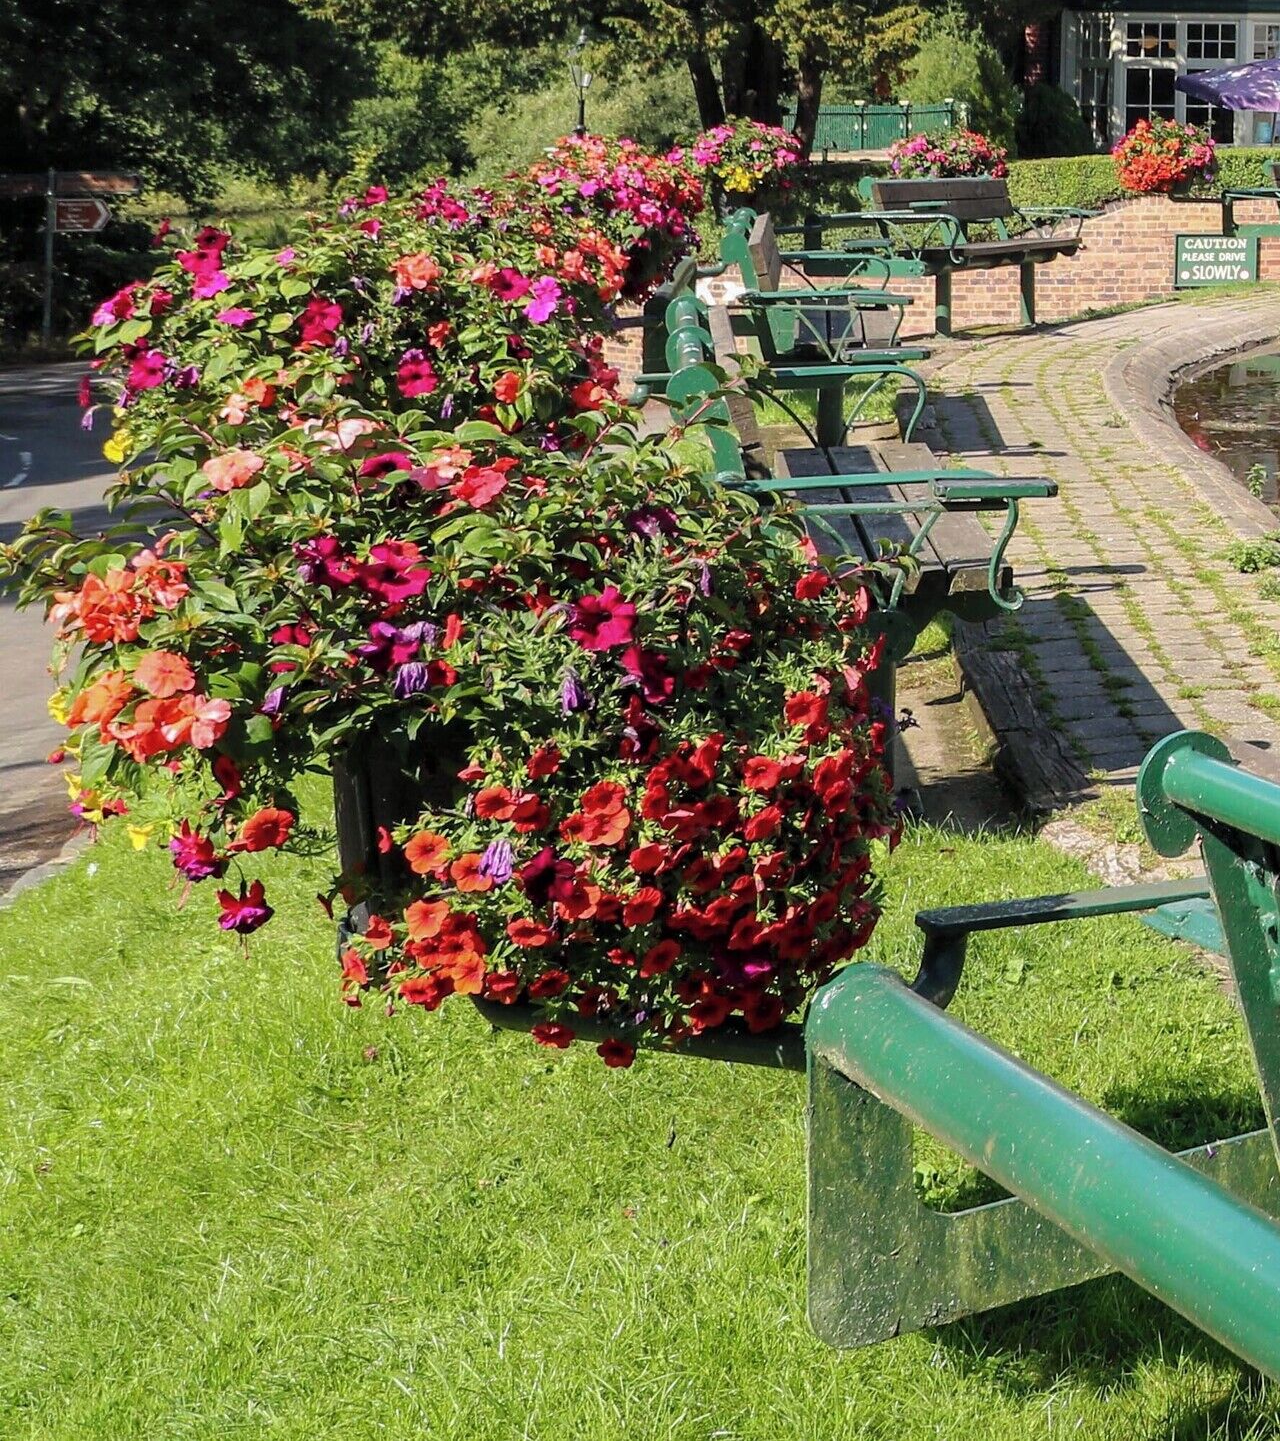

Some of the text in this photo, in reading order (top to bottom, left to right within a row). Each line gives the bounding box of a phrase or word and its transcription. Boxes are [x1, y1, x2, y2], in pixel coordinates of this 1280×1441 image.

[1184, 238, 1247, 249] CAUTION
[1182, 252, 1246, 262] PLEASE DRIVE
[1192, 265, 1241, 280] SLOWLY
